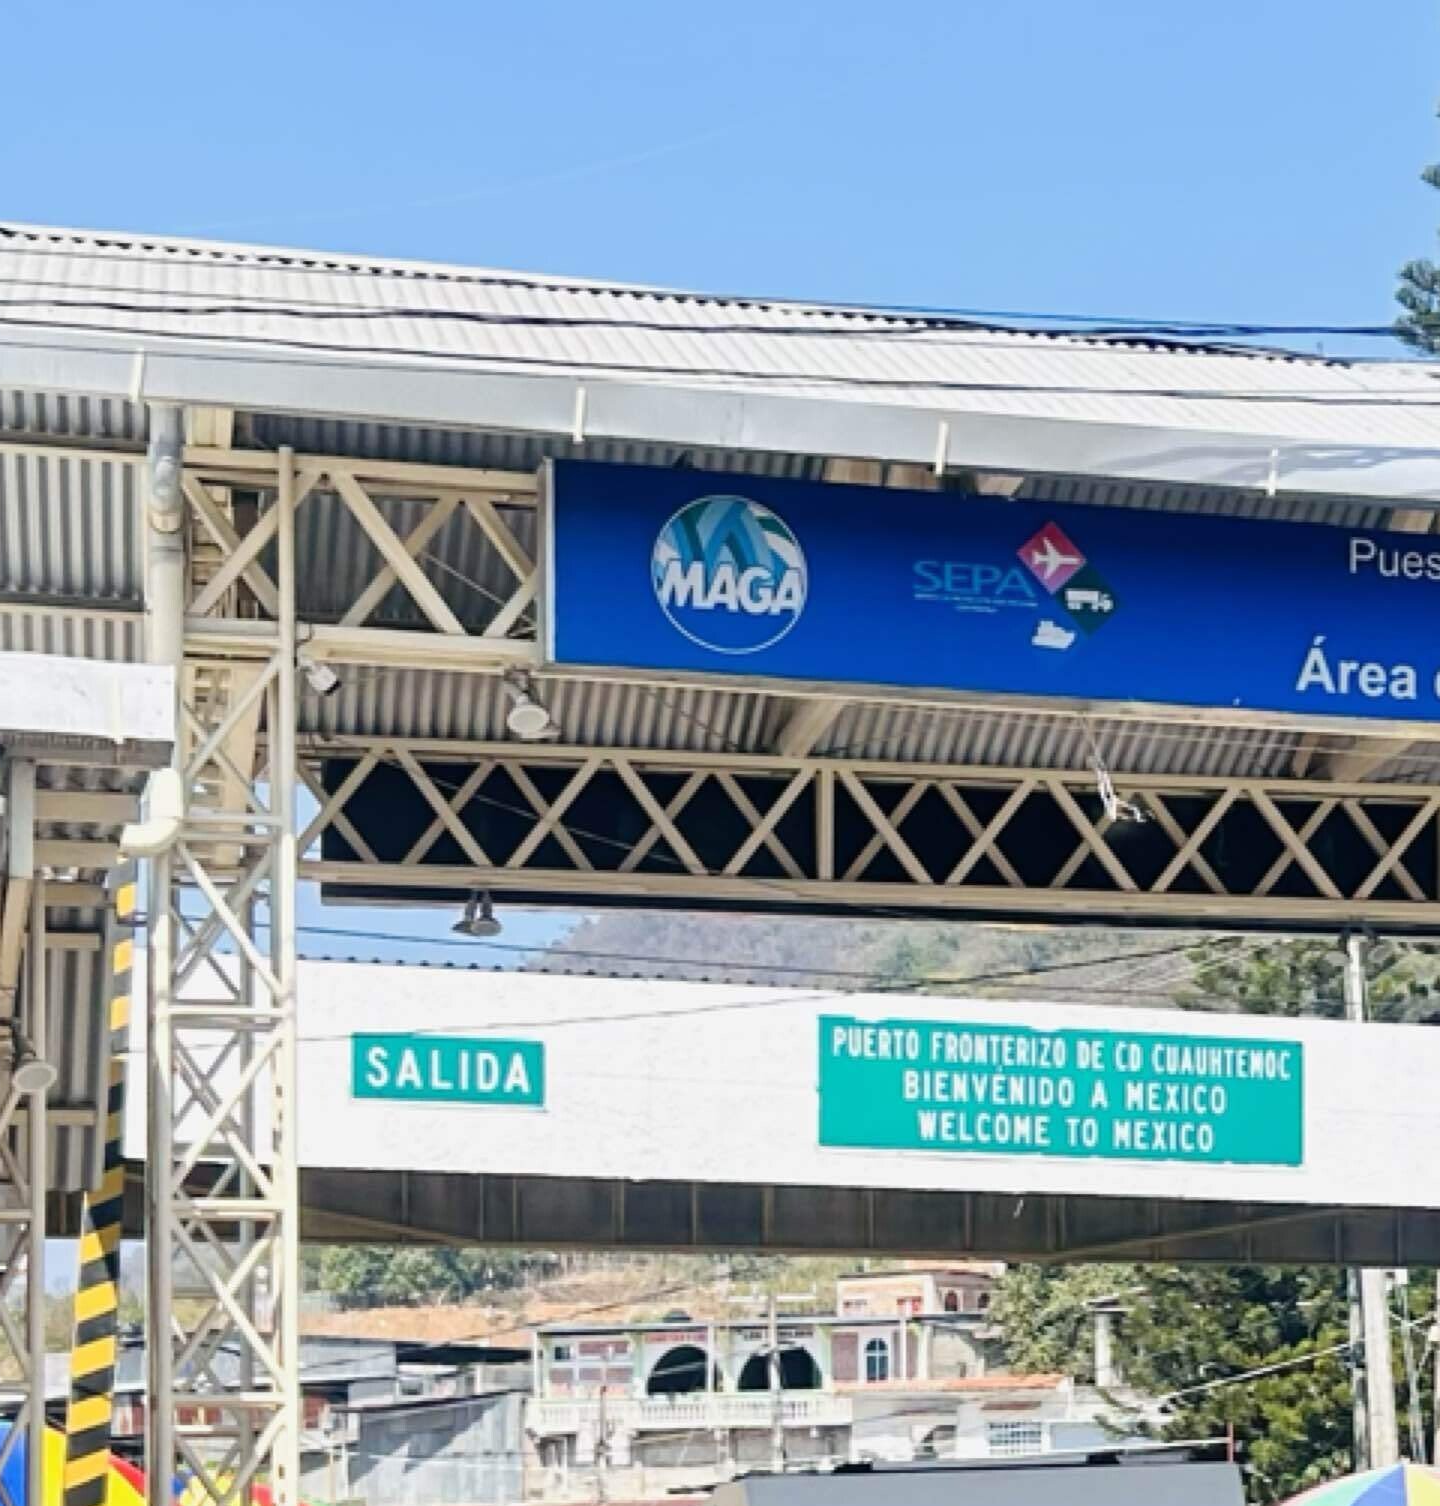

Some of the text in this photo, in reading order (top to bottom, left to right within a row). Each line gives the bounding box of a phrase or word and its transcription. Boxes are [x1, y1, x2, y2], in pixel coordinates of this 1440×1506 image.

[661, 559, 803, 615] MAGA
[912, 560, 1036, 598] SEPA
[1295, 636, 1417, 700] Área
[367, 1046, 532, 1094] SALIDA
[833, 1025, 1291, 1080] PUERTO FRONTERIZO DE CD CUAUHTEMOC
[903, 1069, 1227, 1114] BIENVENIDO A MEXICO
[917, 1109, 1215, 1153] WELCOME TO MEXICO
